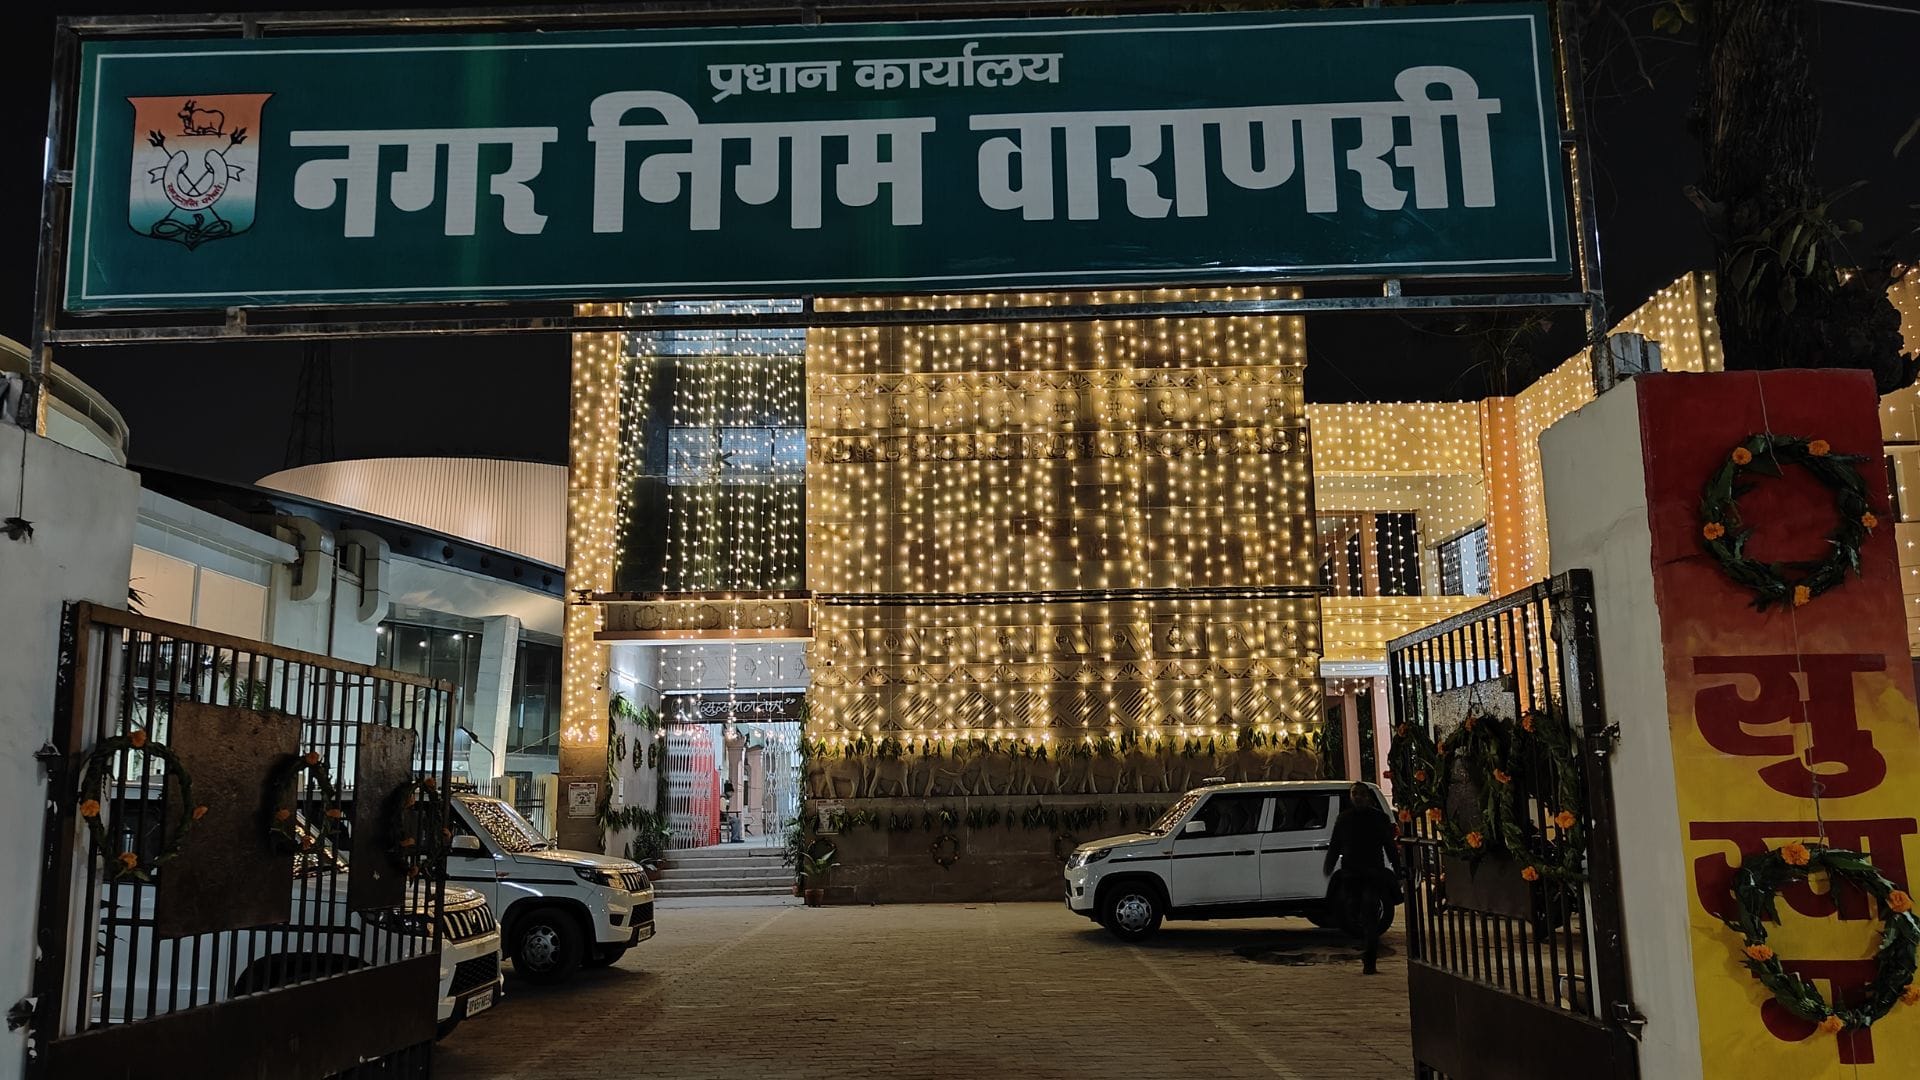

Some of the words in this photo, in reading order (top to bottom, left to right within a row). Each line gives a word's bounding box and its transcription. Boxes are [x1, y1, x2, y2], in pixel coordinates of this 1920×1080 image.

[708, 61, 841, 103] प्रधान
[853, 42, 1064, 90] कार्यालय
[289, 127, 558, 238] नगर
[587, 90, 937, 233] निगम
[969, 65, 1502, 221] वाराणसी
